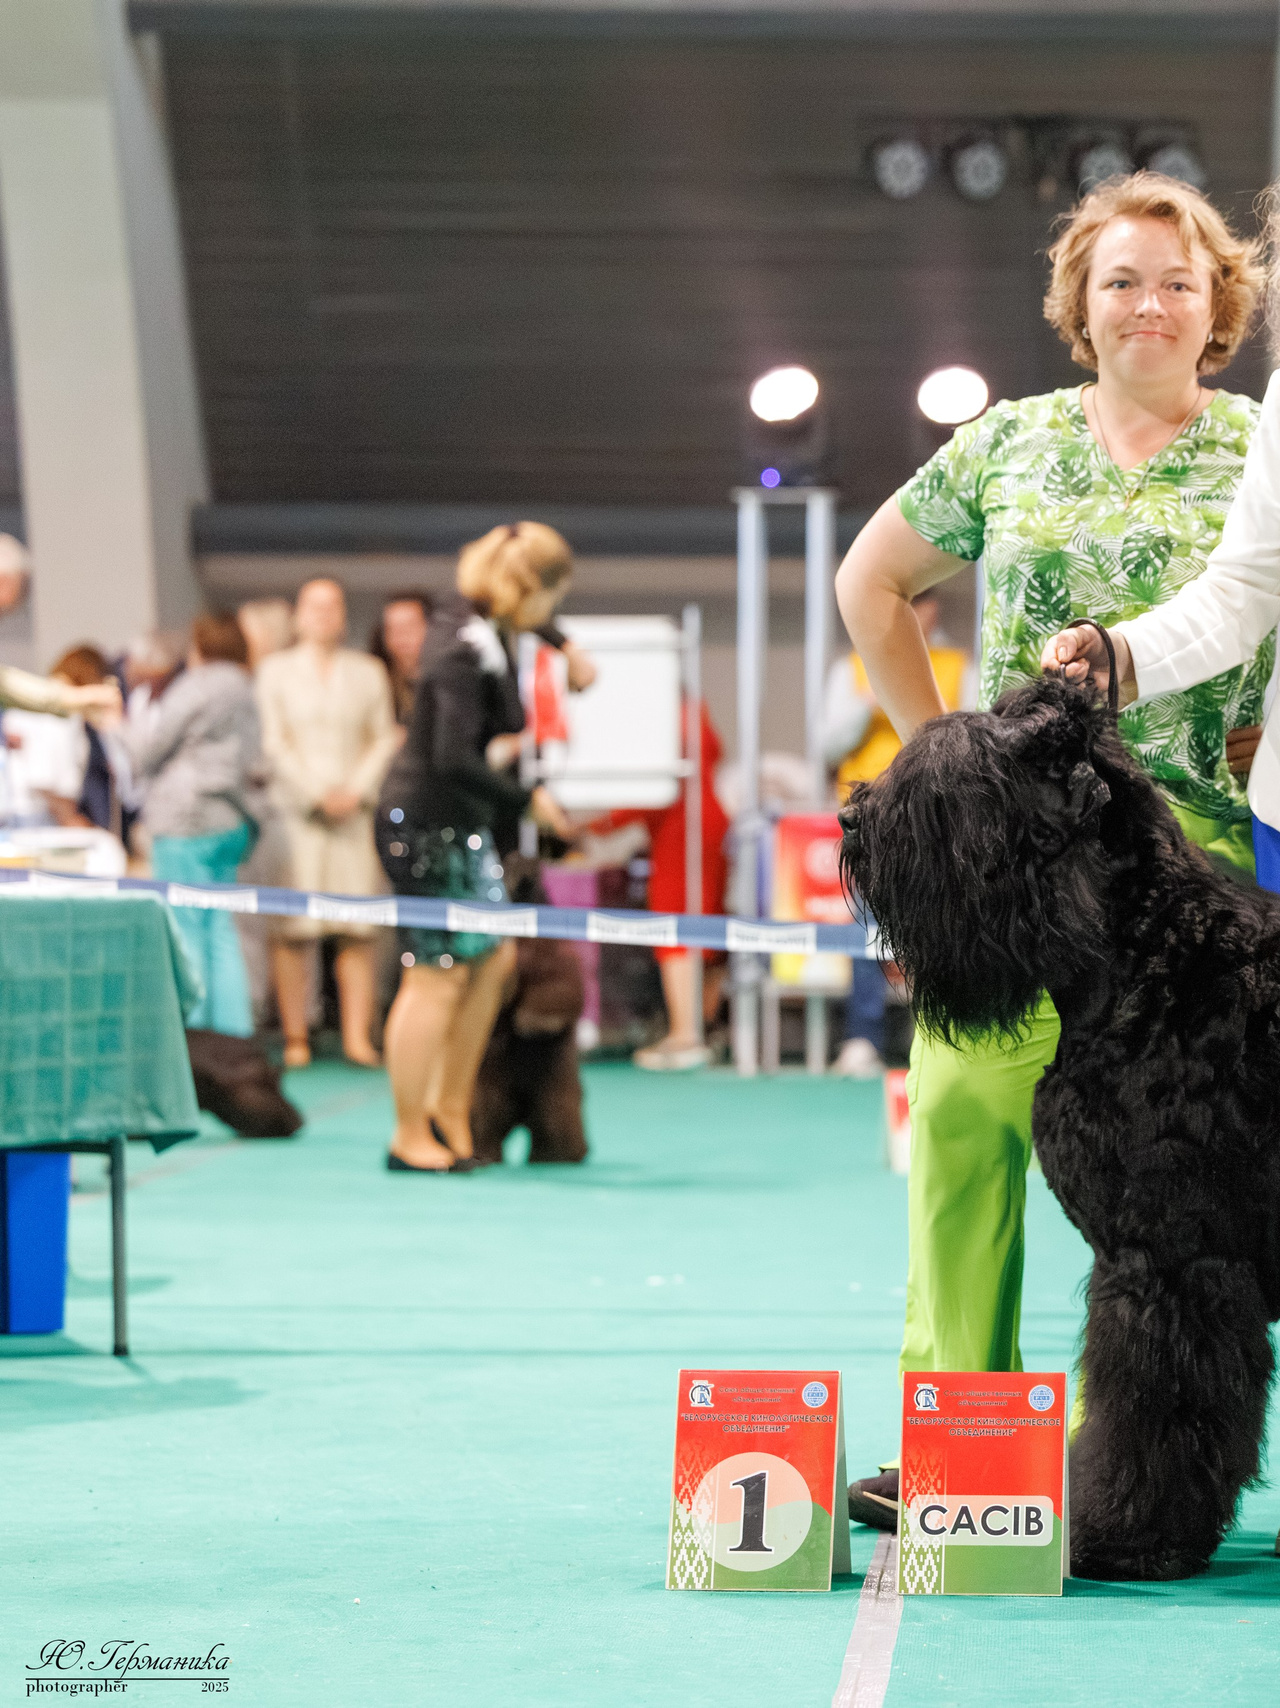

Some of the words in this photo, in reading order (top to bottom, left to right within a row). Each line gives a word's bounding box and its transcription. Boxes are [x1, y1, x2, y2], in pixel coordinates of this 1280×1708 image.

[681, 1413, 749, 1422] "БЕЛОРУССКОЕ
[751, 1413, 833, 1423] КИНОЛОГИЧЕСКОЕ
[907, 1417, 976, 1425] "БЕЛОРУССКОЕ
[977, 1417, 1060, 1426] КИНОЛОГИЧЕСКОЕ
[723, 1424, 790, 1433] ОБЪЕДИНЕНИЕ"
[949, 1428, 1017, 1437] ОБЪЕДИНЕНИЕ"
[728, 1471, 773, 1552] 1
[918, 1504, 1044, 1537] CACIB
